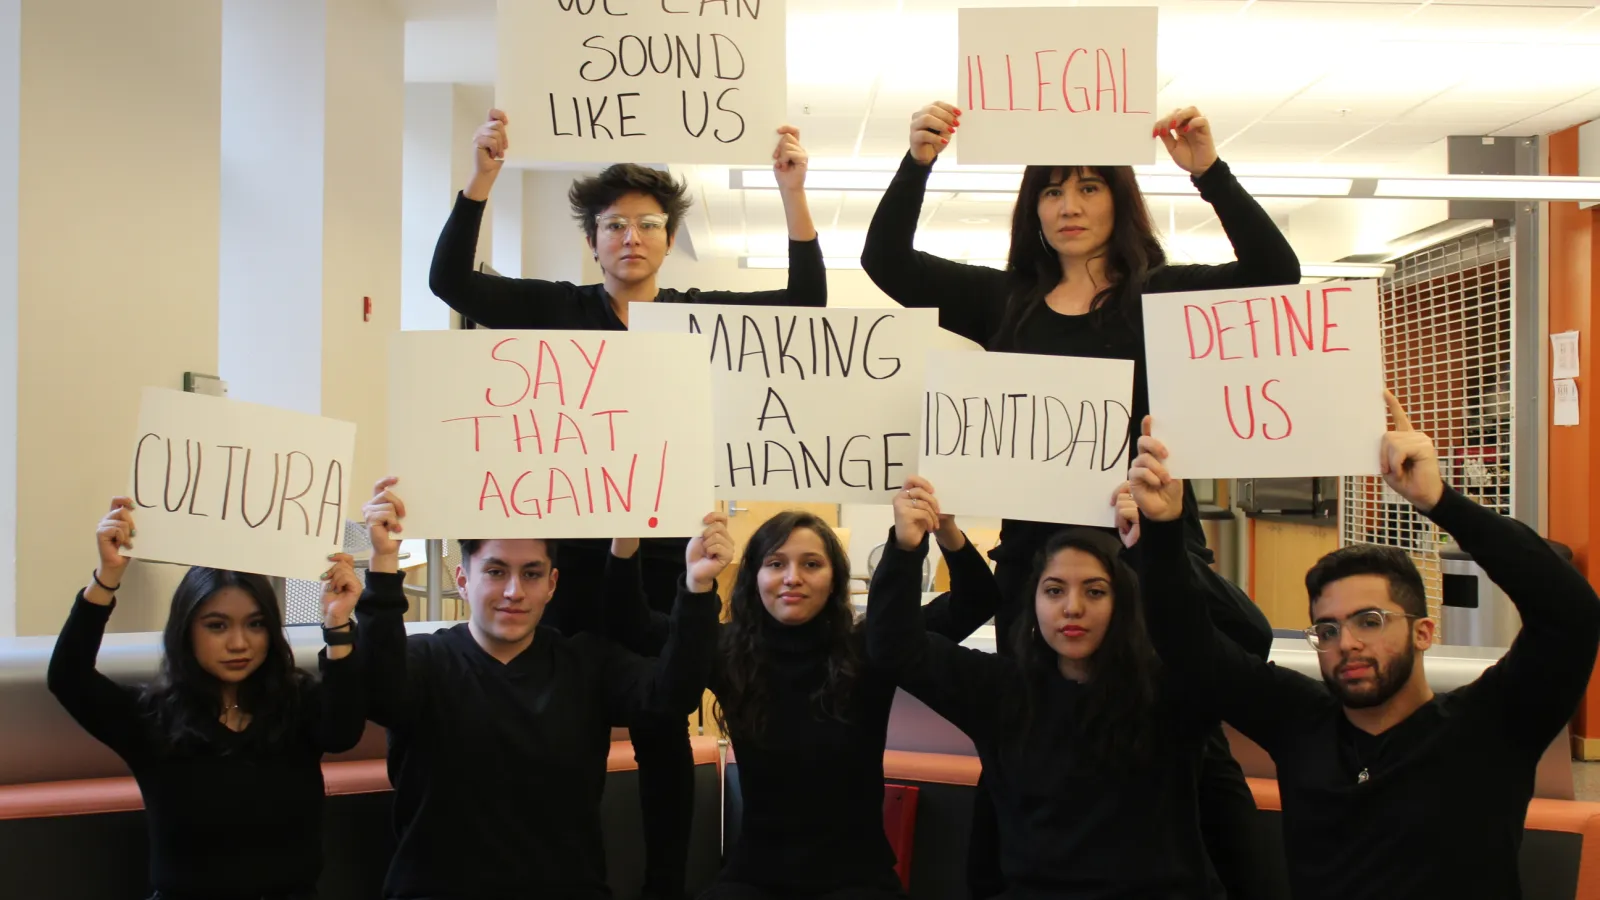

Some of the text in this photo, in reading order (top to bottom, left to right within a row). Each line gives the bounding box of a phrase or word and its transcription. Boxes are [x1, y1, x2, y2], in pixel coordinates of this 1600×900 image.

[579, 33, 745, 81] SOUND
[967, 48, 1151, 114] ILLEGAL
[549, 88, 745, 143] LIKE US
[1184, 287, 1352, 360] DEFINE
[485, 338, 606, 409] SAY
[441, 409, 629, 455] THAT
[757, 387, 796, 434] A
[925, 391, 1131, 472] IDENTIDAD
[1224, 379, 1292, 440] US
[134, 433, 343, 545] CULTURA
[478, 440, 668, 528] AGAIN!
[714, 433, 911, 491] HANGE
